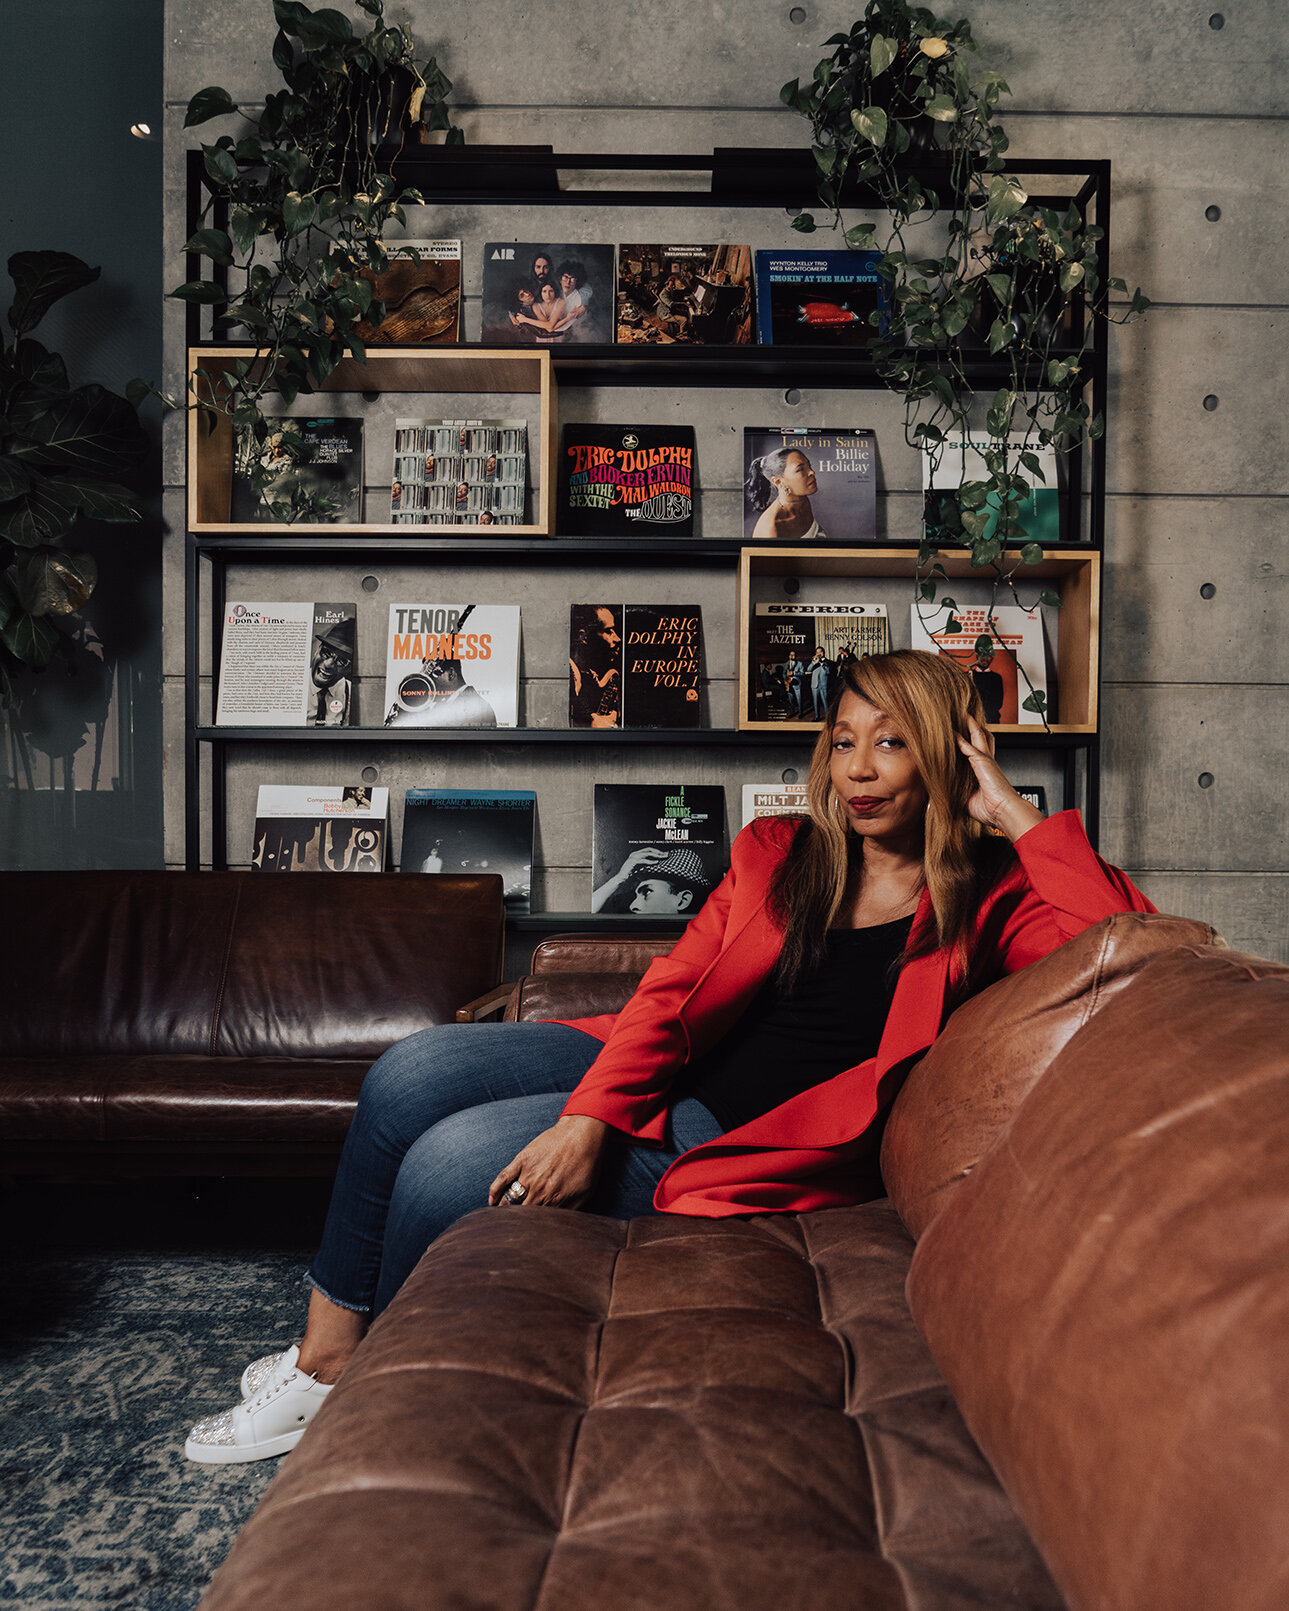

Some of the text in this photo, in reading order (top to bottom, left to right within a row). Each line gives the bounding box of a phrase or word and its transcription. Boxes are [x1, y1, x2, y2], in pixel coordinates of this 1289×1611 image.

[491, 248, 515, 260] AIR
[834, 275, 855, 283] HALF
[857, 275, 878, 283] NOTE
[782, 436, 869, 449] Lady in Satin
[568, 445, 693, 474] ERIC DOLPHY
[836, 449, 869, 460] Billie
[819, 460, 870, 474] Holiday
[569, 463, 692, 488] AND BOOKER ERVIN
[570, 483, 616, 500] WITH THE
[610, 481, 692, 506] MAL WALDRON
[569, 494, 611, 510] SEXTET
[625, 508, 641, 518] THE
[233, 605, 261, 618] Once
[768, 605, 865, 614] STEREO
[228, 616, 252, 625] Upon
[261, 616, 285, 624] Time
[315, 616, 340, 624] Hines
[395, 609, 460, 634] TENOR
[656, 617, 699, 631] ERIC
[776, 624, 795, 634] THE
[627, 631, 698, 645] DOLPHY
[769, 634, 806, 645] JAZZTET
[393, 633, 492, 660] MADNESS
[676, 645, 698, 659] IN
[631, 659, 699, 673] EUROPE
[691, 674, 698, 687] 1
[680, 785, 685, 796] A
[406, 798, 531, 808] NIGHT DREAMER WAYNE SHORTER
[664, 796, 685, 807] FICKLE
[757, 795, 788, 805] MILT
[664, 807, 691, 818] SONANCE
[655, 818, 677, 830] JACKIE
